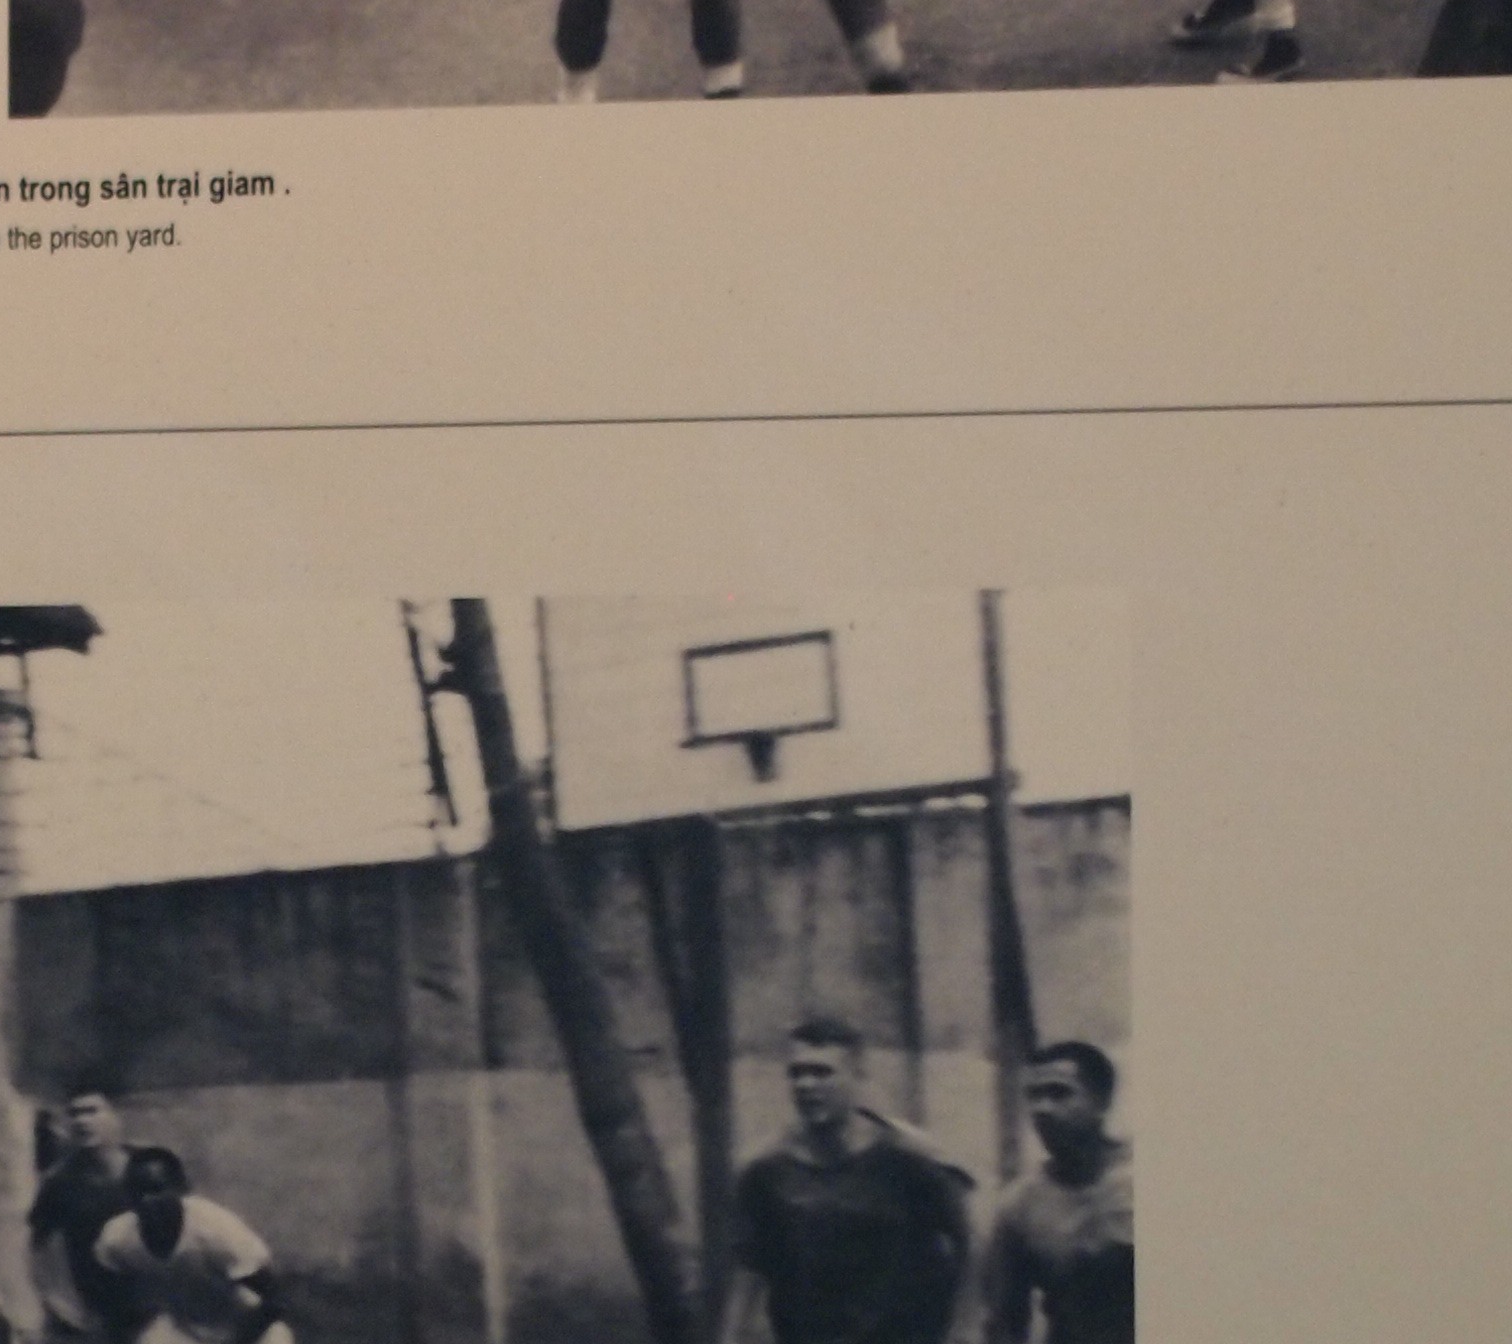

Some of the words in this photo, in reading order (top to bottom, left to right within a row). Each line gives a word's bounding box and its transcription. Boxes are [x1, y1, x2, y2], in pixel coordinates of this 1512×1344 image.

[19, 176, 91, 208] trong
[99, 172, 148, 200] sân
[156, 171, 201, 206] trại
[208, 169, 276, 204] giam
[7, 226, 43, 251] the
[49, 225, 119, 254] prison
[126, 223, 181, 253] yard.
